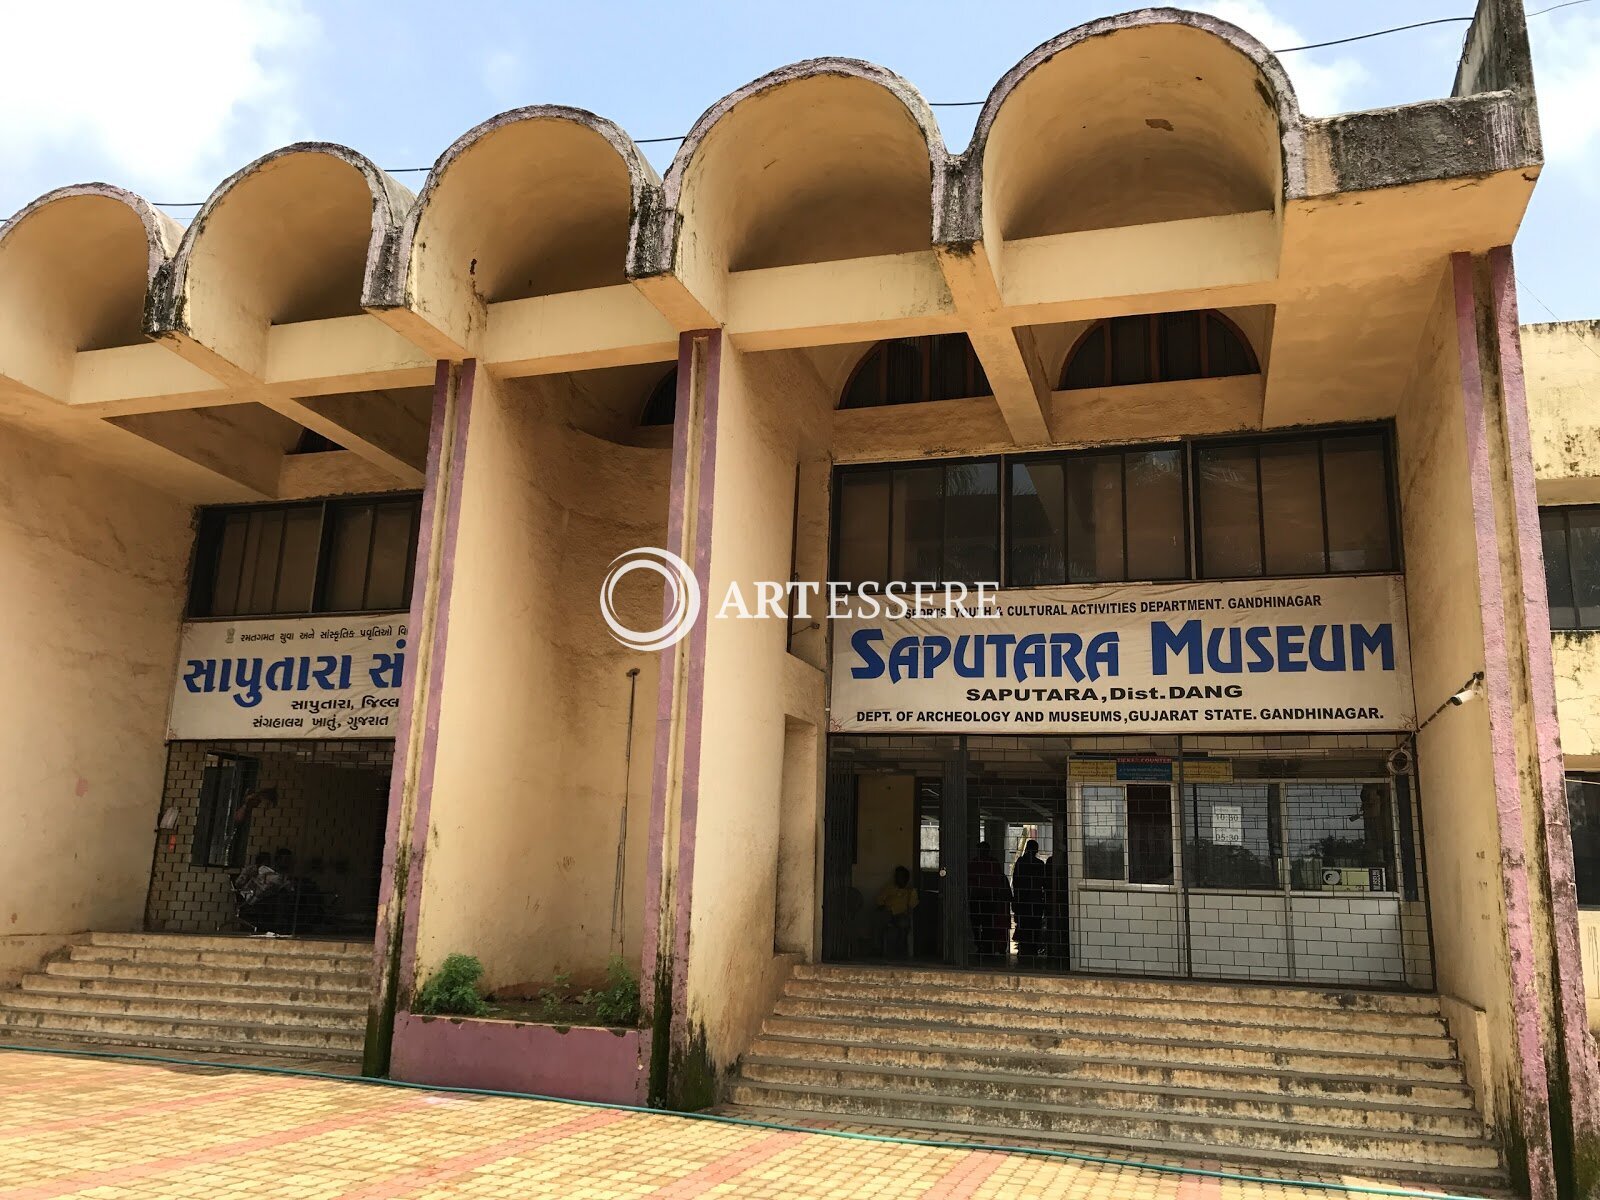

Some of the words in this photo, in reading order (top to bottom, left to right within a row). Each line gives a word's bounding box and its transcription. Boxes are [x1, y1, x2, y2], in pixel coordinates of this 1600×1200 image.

[1007, 603, 1068, 616] CULTURAL
[1070, 602, 1137, 615] ACTIVITIES
[1140, 599, 1225, 613] DEPARTMENT.
[1228, 595, 1322, 609] GANDHINAGAR
[240, 632, 275, 642] રમતગમત
[299, 628, 316, 640] અને
[850, 628, 1120, 684] SAPUTARA
[1150, 619, 1396, 676] MUSEUM
[183, 655, 353, 708] સાપુતારા
[290, 699, 354, 714] સાપુતારા,
[252, 714, 304, 728] સંગ્રહાલય
[346, 715, 390, 731] ગુજરાત
[856, 710, 893, 722] DEPT.
[896, 710, 914, 722] OF
[916, 710, 1011, 723] ARCHEOLOGY
[1014, 710, 1045, 723] AND
